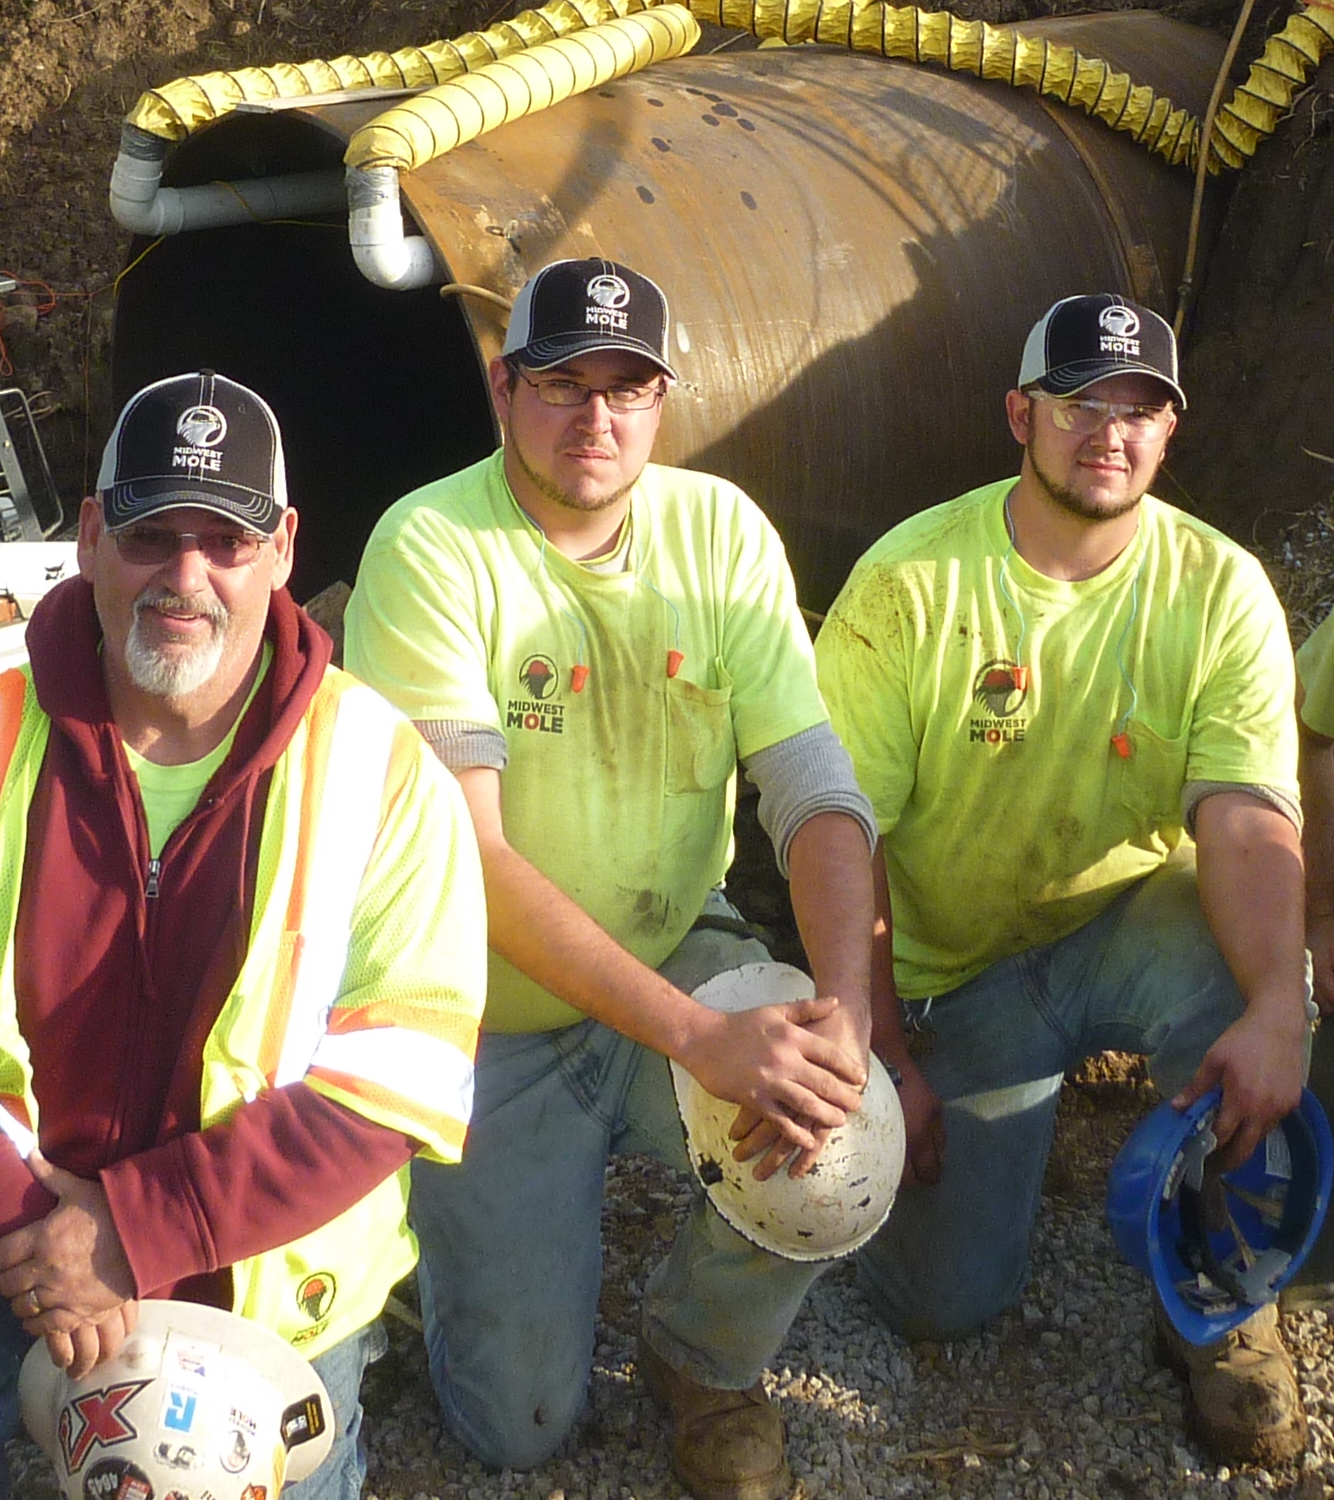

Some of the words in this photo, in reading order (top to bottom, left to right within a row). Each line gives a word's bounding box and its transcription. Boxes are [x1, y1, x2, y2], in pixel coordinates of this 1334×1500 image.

[585, 306, 629, 320] MIDWEST
[585, 313, 629, 330] MOLE
[1100, 342, 1141, 356] MOLE
[173, 446, 224, 460] MIDWEST
[172, 454, 222, 472] MOLE
[508, 700, 566, 716] MIDWEST
[506, 711, 564, 734] MOLE
[970, 718, 1026, 729] MIDWEST
[969, 728, 1025, 743] MOLE
